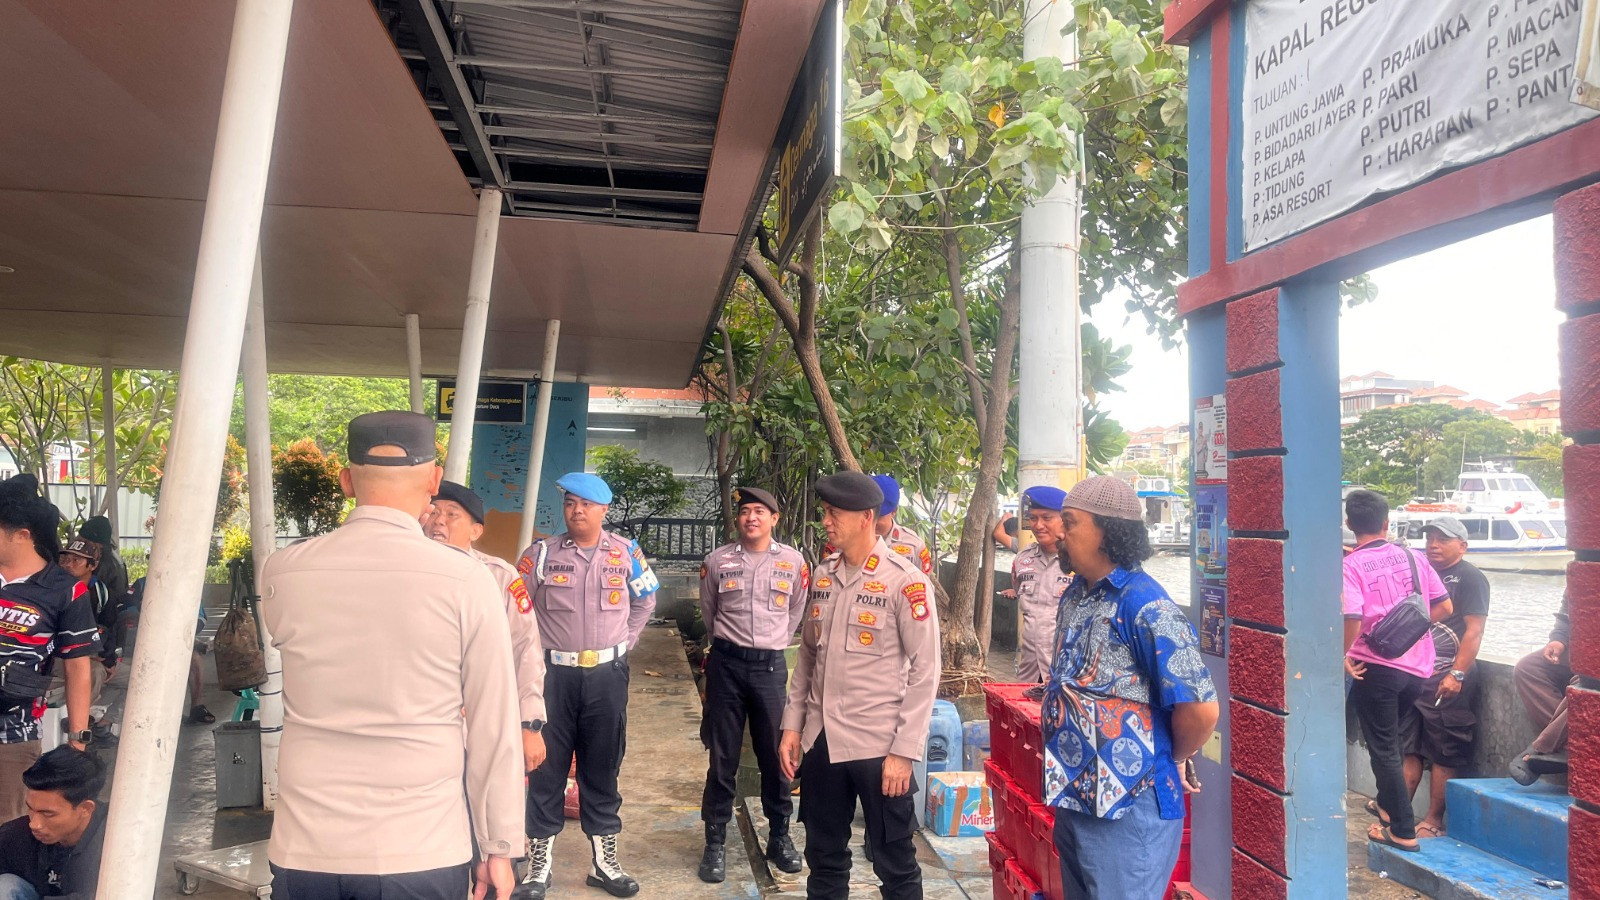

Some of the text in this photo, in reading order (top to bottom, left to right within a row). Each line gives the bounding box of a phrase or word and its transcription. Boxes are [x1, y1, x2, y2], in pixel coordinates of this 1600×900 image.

[1255, 0, 1379, 80] KAPAL REG
[1381, 12, 1471, 80] PRAMUKA
[1507, 0, 1579, 48] MACAN
[1508, 37, 1561, 79] SEPA
[1253, 74, 1297, 114] TUJUAN
[1264, 102, 1309, 139] UNTUNG
[1311, 83, 1345, 114] JAWA
[1378, 70, 1418, 109] PARI
[1264, 121, 1315, 161] BIDADARI
[1324, 98, 1356, 130] AYER
[1378, 95, 1431, 139] PUTRI
[1387, 106, 1474, 166] HARAPAN
[1264, 148, 1306, 182] KELAPA
[1262, 202, 1284, 224] ASA
[1286, 179, 1333, 214] RESORT
[855, 594, 887, 608] POLRI
